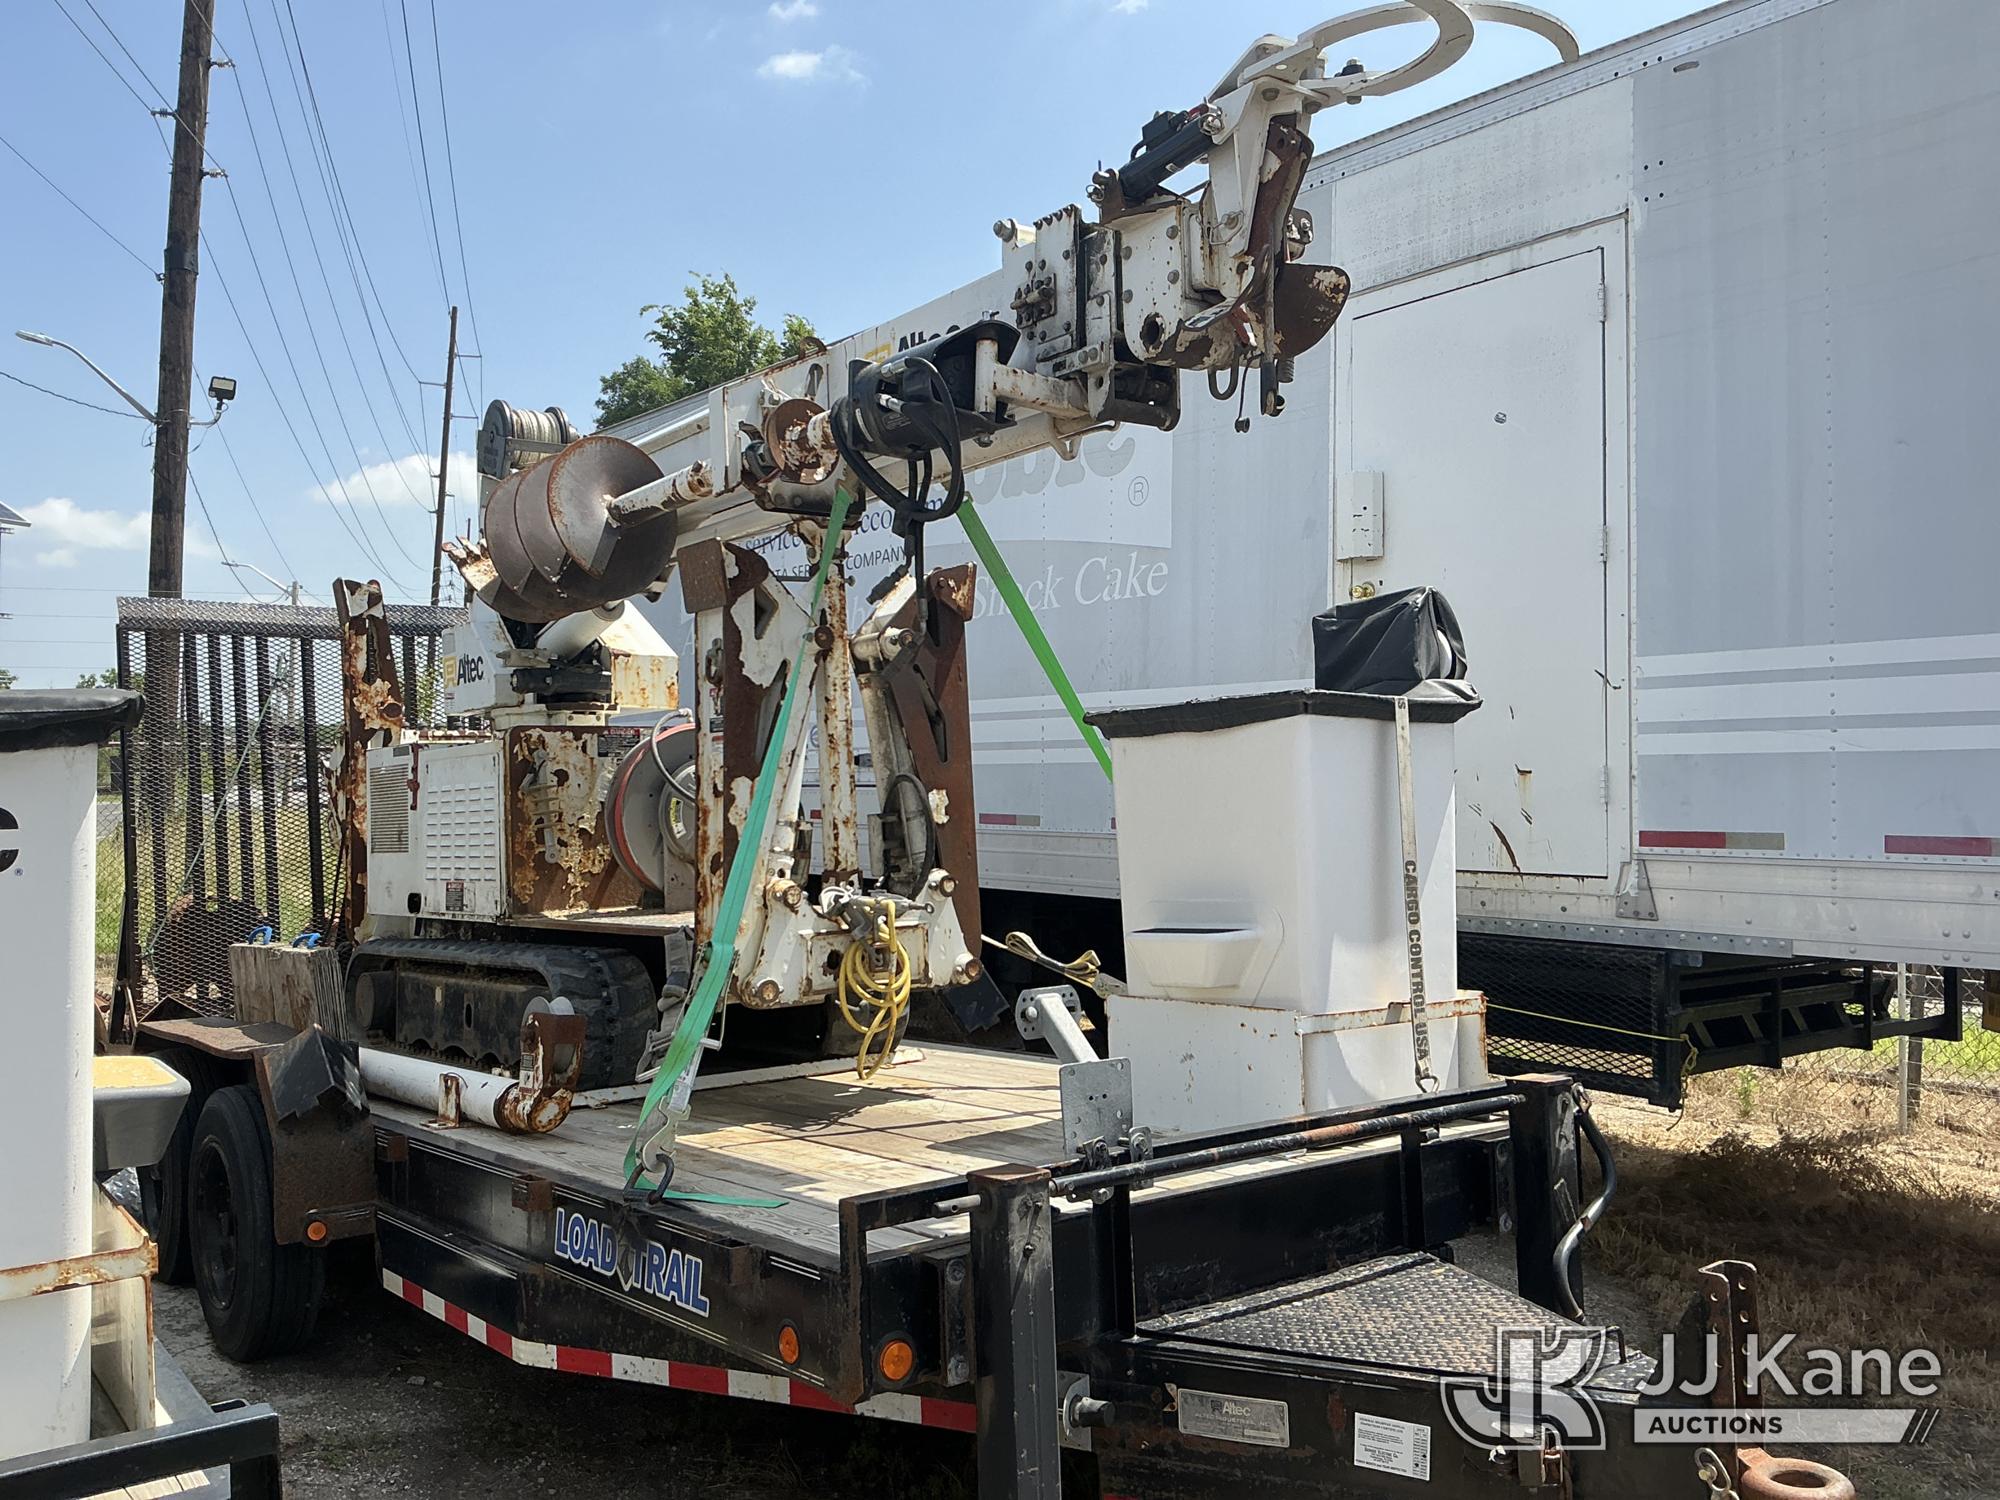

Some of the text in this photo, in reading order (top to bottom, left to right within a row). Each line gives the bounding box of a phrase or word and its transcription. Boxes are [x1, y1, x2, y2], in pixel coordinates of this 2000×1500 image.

[972, 564, 1065, 620] Snck
[1073, 550, 1169, 606] Cake
[457, 653, 484, 686] Altec
[1405, 860, 1429, 1061] CARGO CONTROL USA
[555, 1207, 710, 1318] LOAD TRAIL
[1222, 1401, 1251, 1416] Altec
